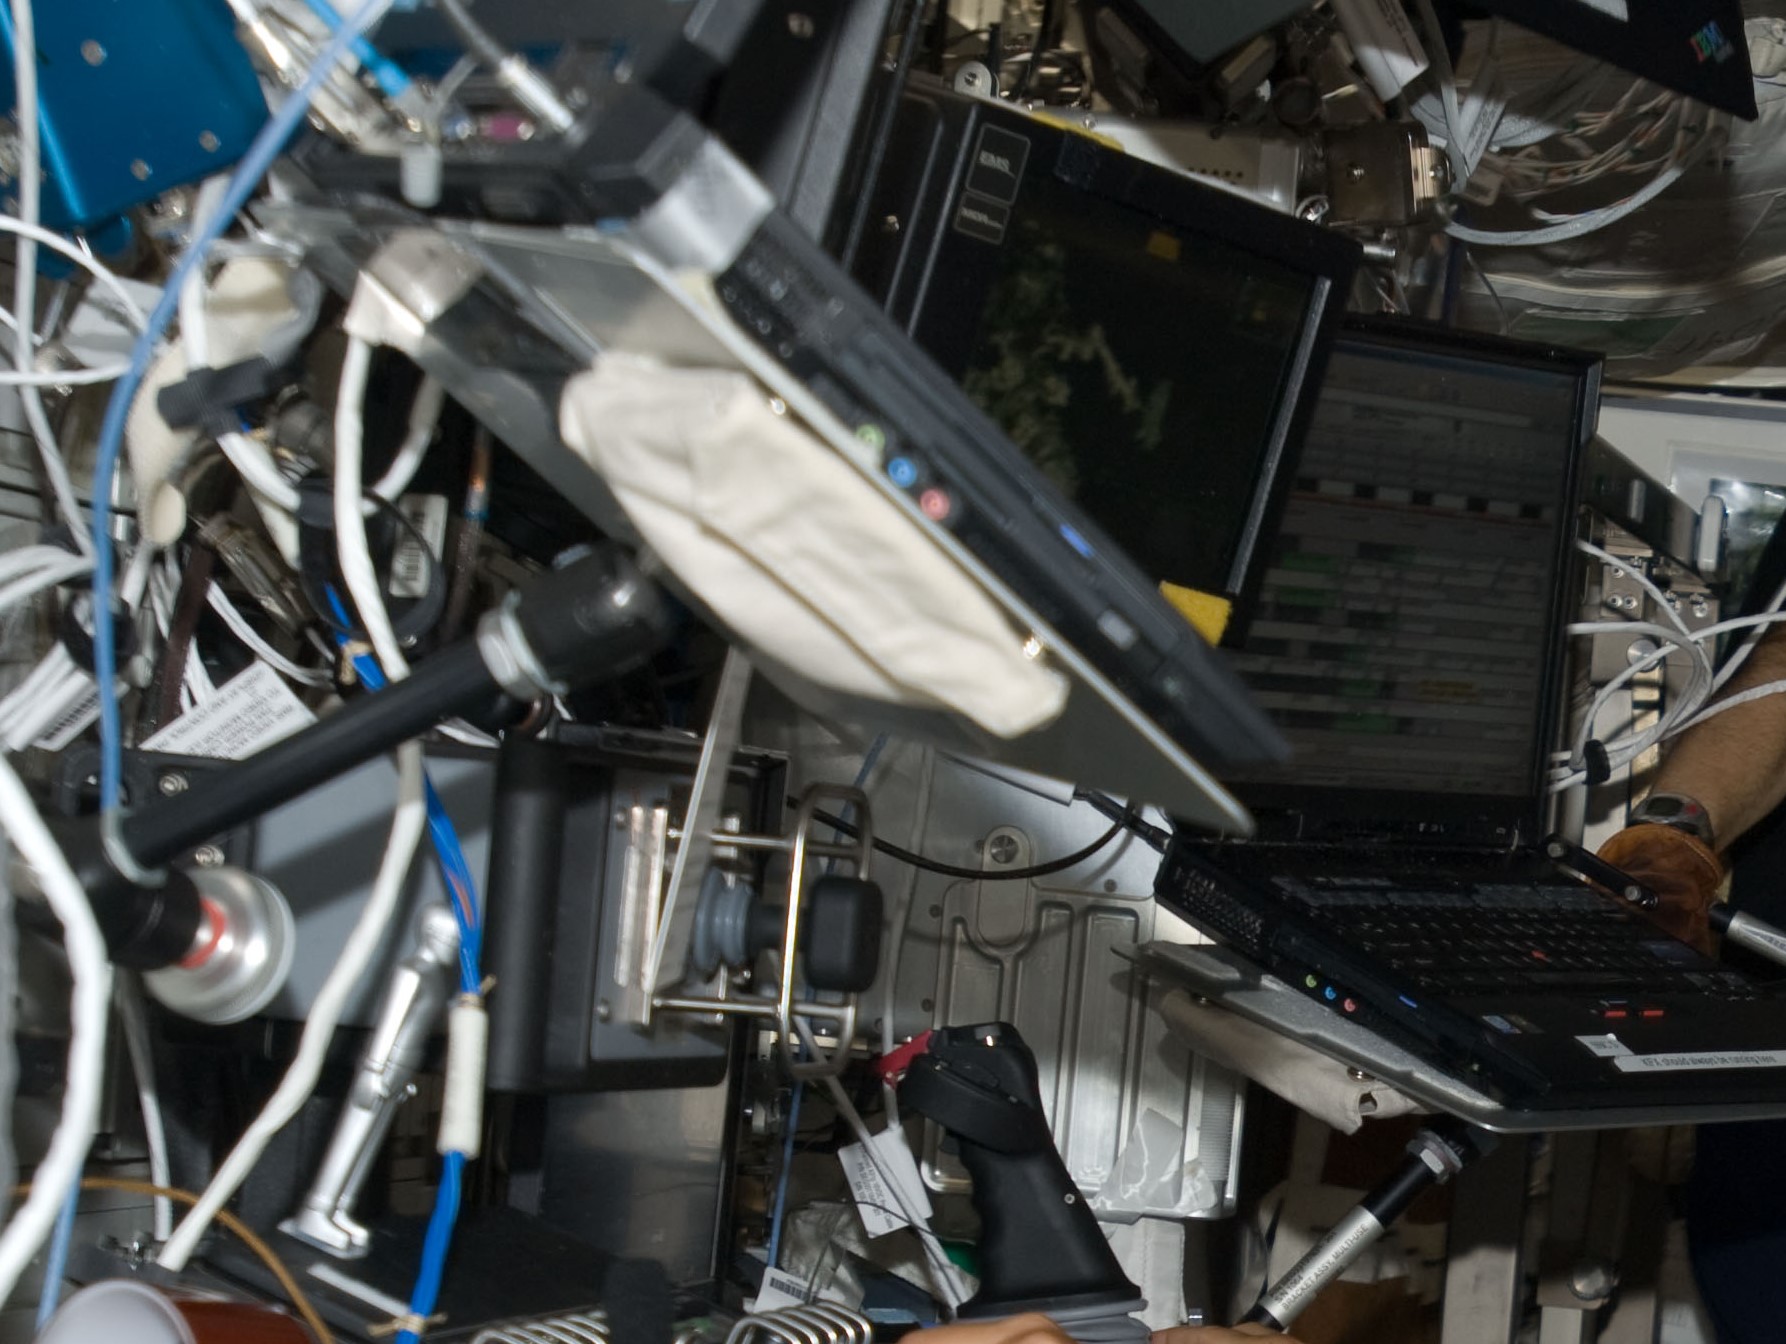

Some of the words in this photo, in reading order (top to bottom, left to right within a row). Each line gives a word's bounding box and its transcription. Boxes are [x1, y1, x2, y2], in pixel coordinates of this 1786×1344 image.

[1690, 21, 1723, 62] IBM
[1281, 1277, 1312, 1310] BRACKET
[1332, 1224, 1368, 1260] MULTI-USE
